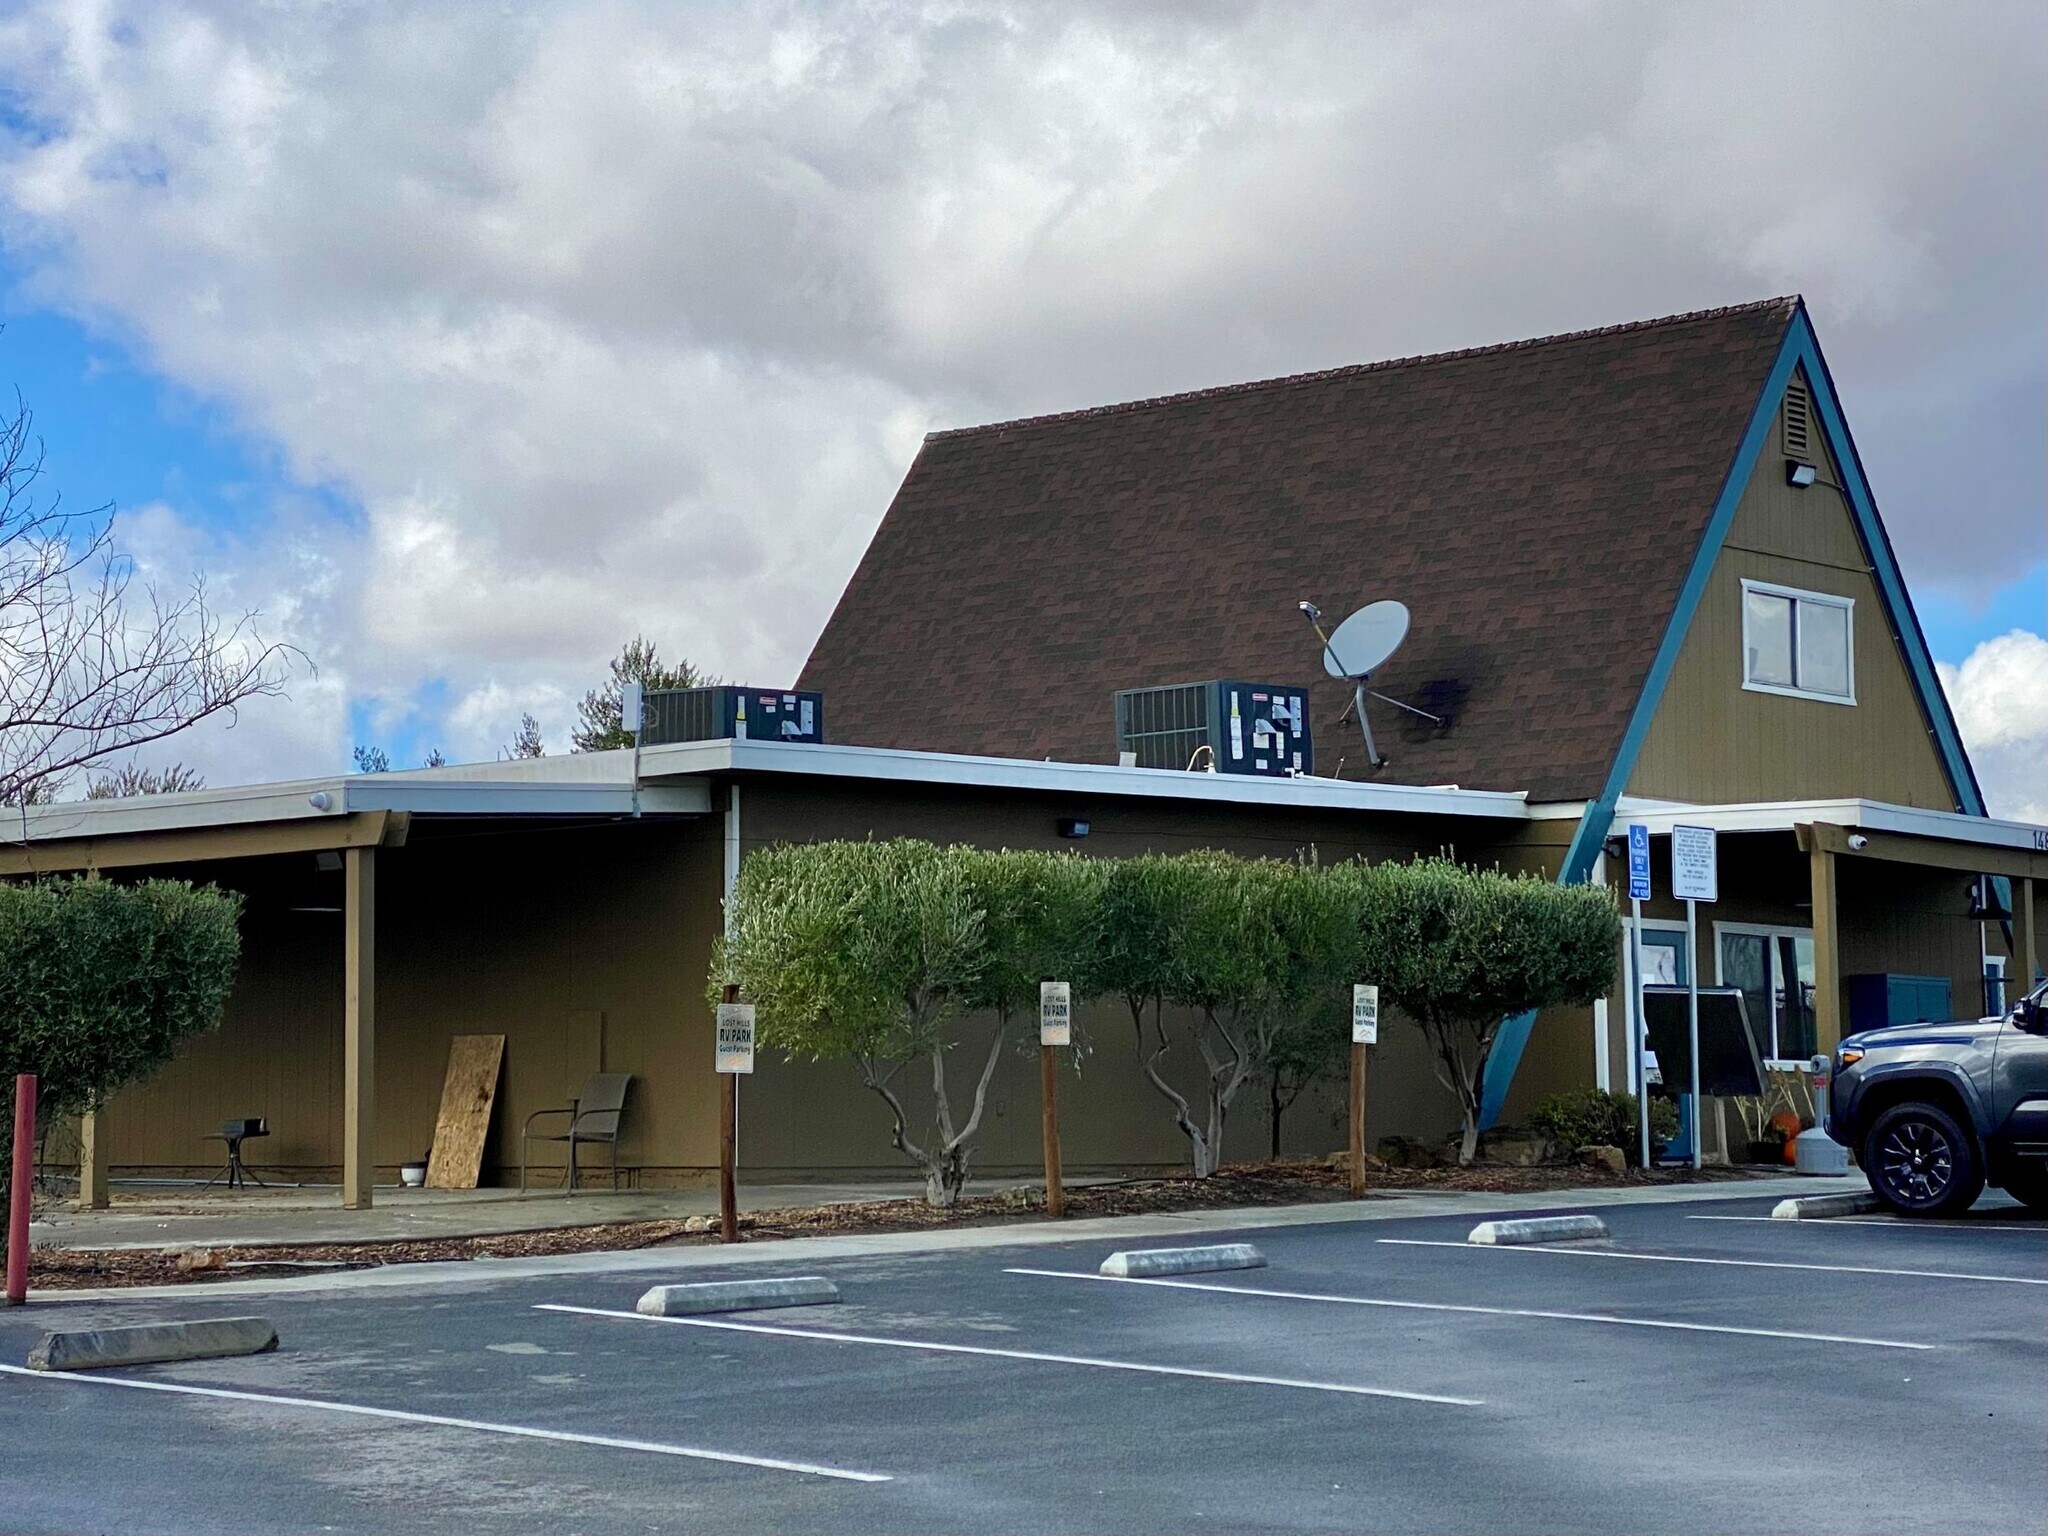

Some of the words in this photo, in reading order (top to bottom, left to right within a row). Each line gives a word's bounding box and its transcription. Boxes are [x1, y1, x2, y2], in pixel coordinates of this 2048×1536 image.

[1043, 1005, 1051, 1016] RV
[1052, 1005, 1067, 1017] PARK
[1355, 1005, 1362, 1016] RV
[1362, 1005, 1375, 1017] PARK
[722, 1019, 736, 1027] LOST
[737, 1019, 750, 1027] HILLS
[719, 1029, 731, 1042] RV
[731, 1029, 752, 1043] PARK
[719, 1044, 733, 1053] Guest
